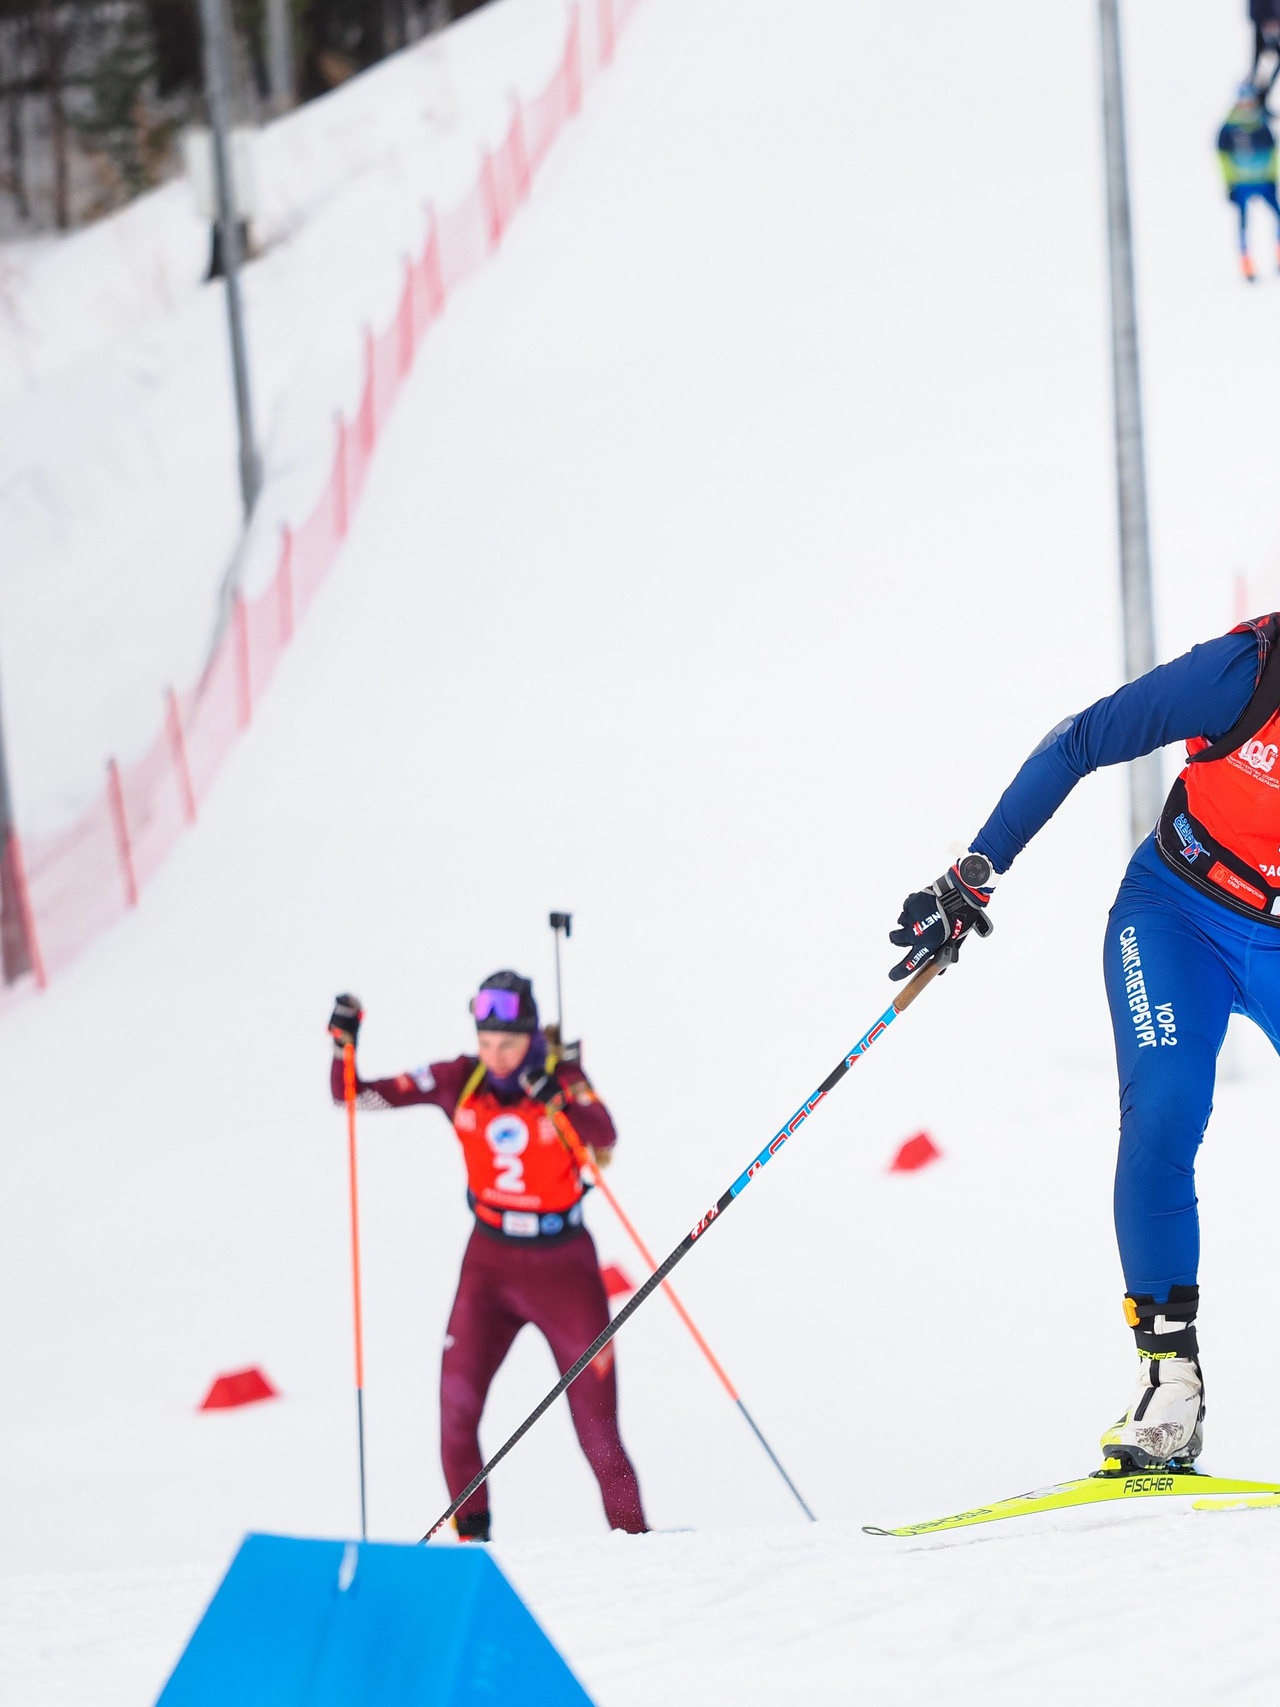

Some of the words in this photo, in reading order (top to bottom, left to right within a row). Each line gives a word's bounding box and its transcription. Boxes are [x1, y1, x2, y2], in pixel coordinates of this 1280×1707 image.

[1119, 926, 1157, 1048] САНКТ-ПЕТЕРБУРГ
[1154, 1002, 1178, 1047] УОР-2
[493, 1153, 526, 1194] 2
[1123, 1477, 1174, 1494] FISCHER
